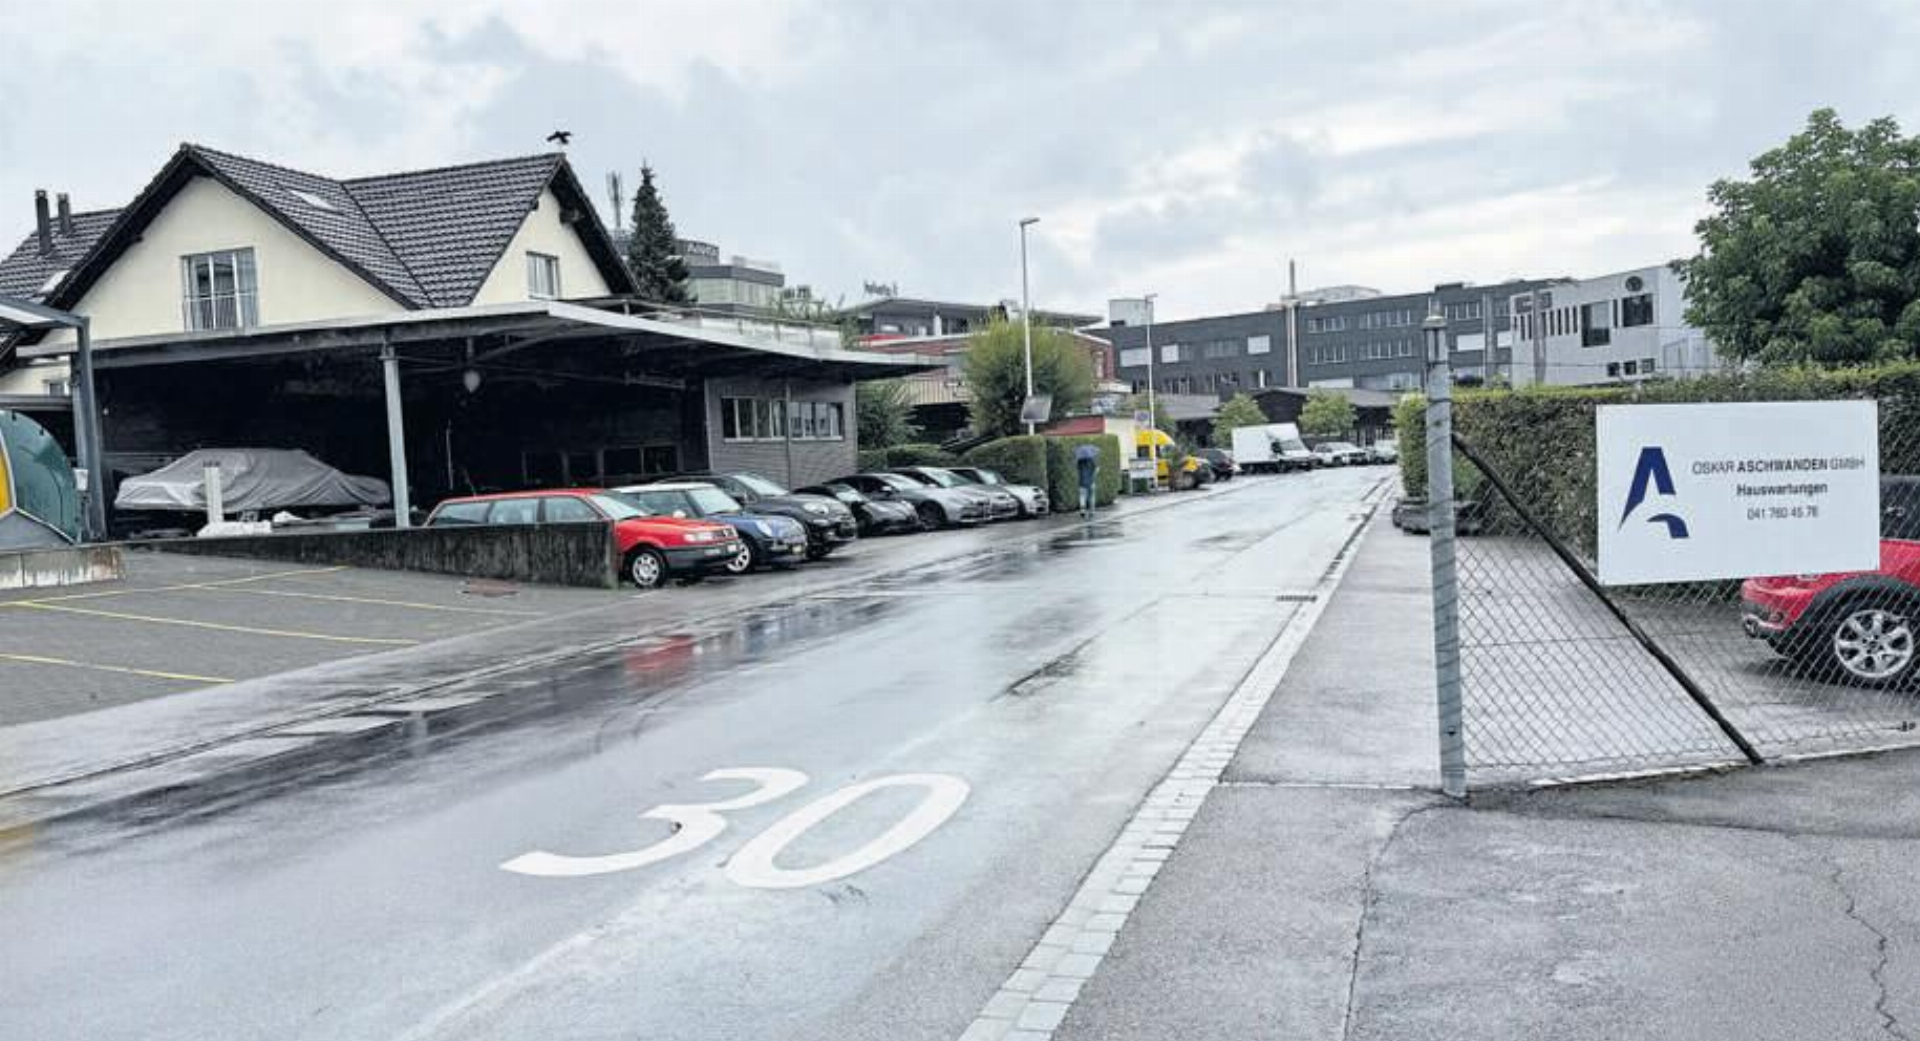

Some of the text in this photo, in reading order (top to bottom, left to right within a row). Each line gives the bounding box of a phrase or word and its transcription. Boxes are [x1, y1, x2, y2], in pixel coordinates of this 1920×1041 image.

[1692, 461, 1735, 475] OSKAR
[1737, 458, 1828, 473] ASCHWANDEN
[1736, 483, 1828, 496] Hauswartungen
[1747, 508, 1765, 520] 041
[499, 767, 971, 888] 30
